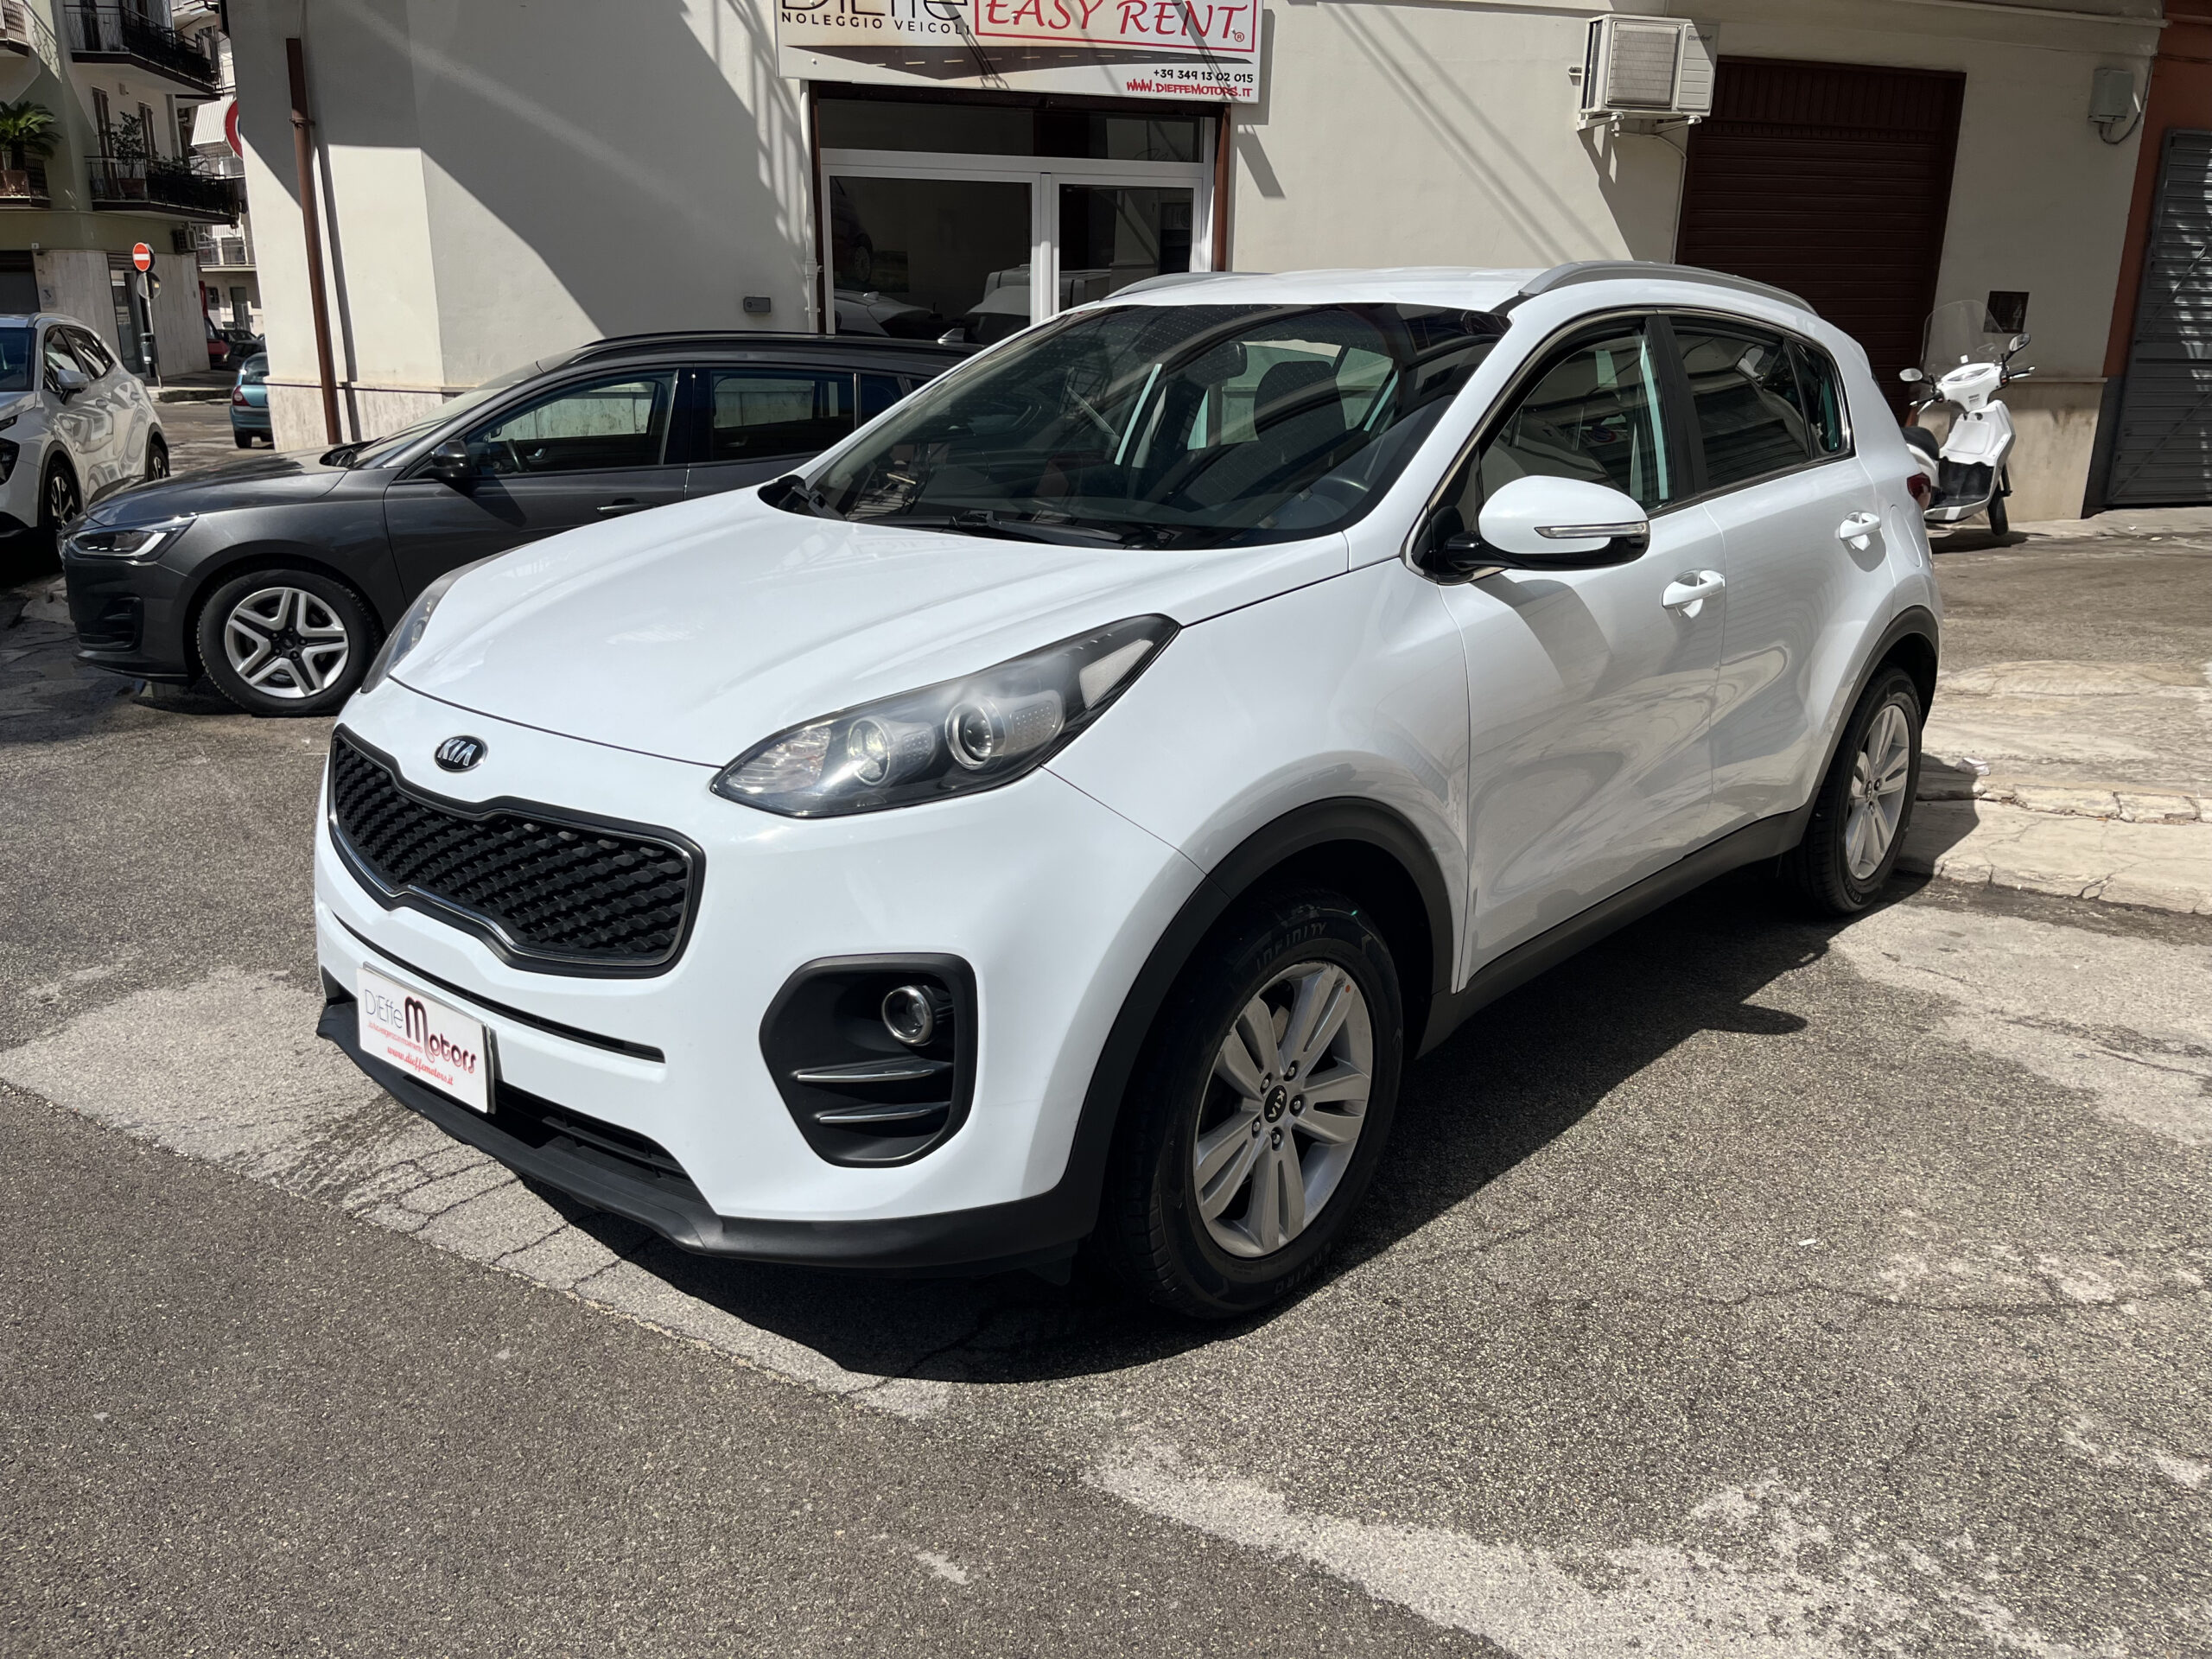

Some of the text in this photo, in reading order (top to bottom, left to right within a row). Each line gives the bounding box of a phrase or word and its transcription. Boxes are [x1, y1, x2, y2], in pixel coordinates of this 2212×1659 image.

[782, 12, 970, 35] NOLEGGIO VEICOLI
[986, 0, 1103, 29] EASY
[1117, 1, 1248, 38] RENT
[1154, 69, 1253, 83] +39 349 13 02 015
[437, 739, 477, 766] KIA
[1268, 1090, 1285, 1117] KIA
